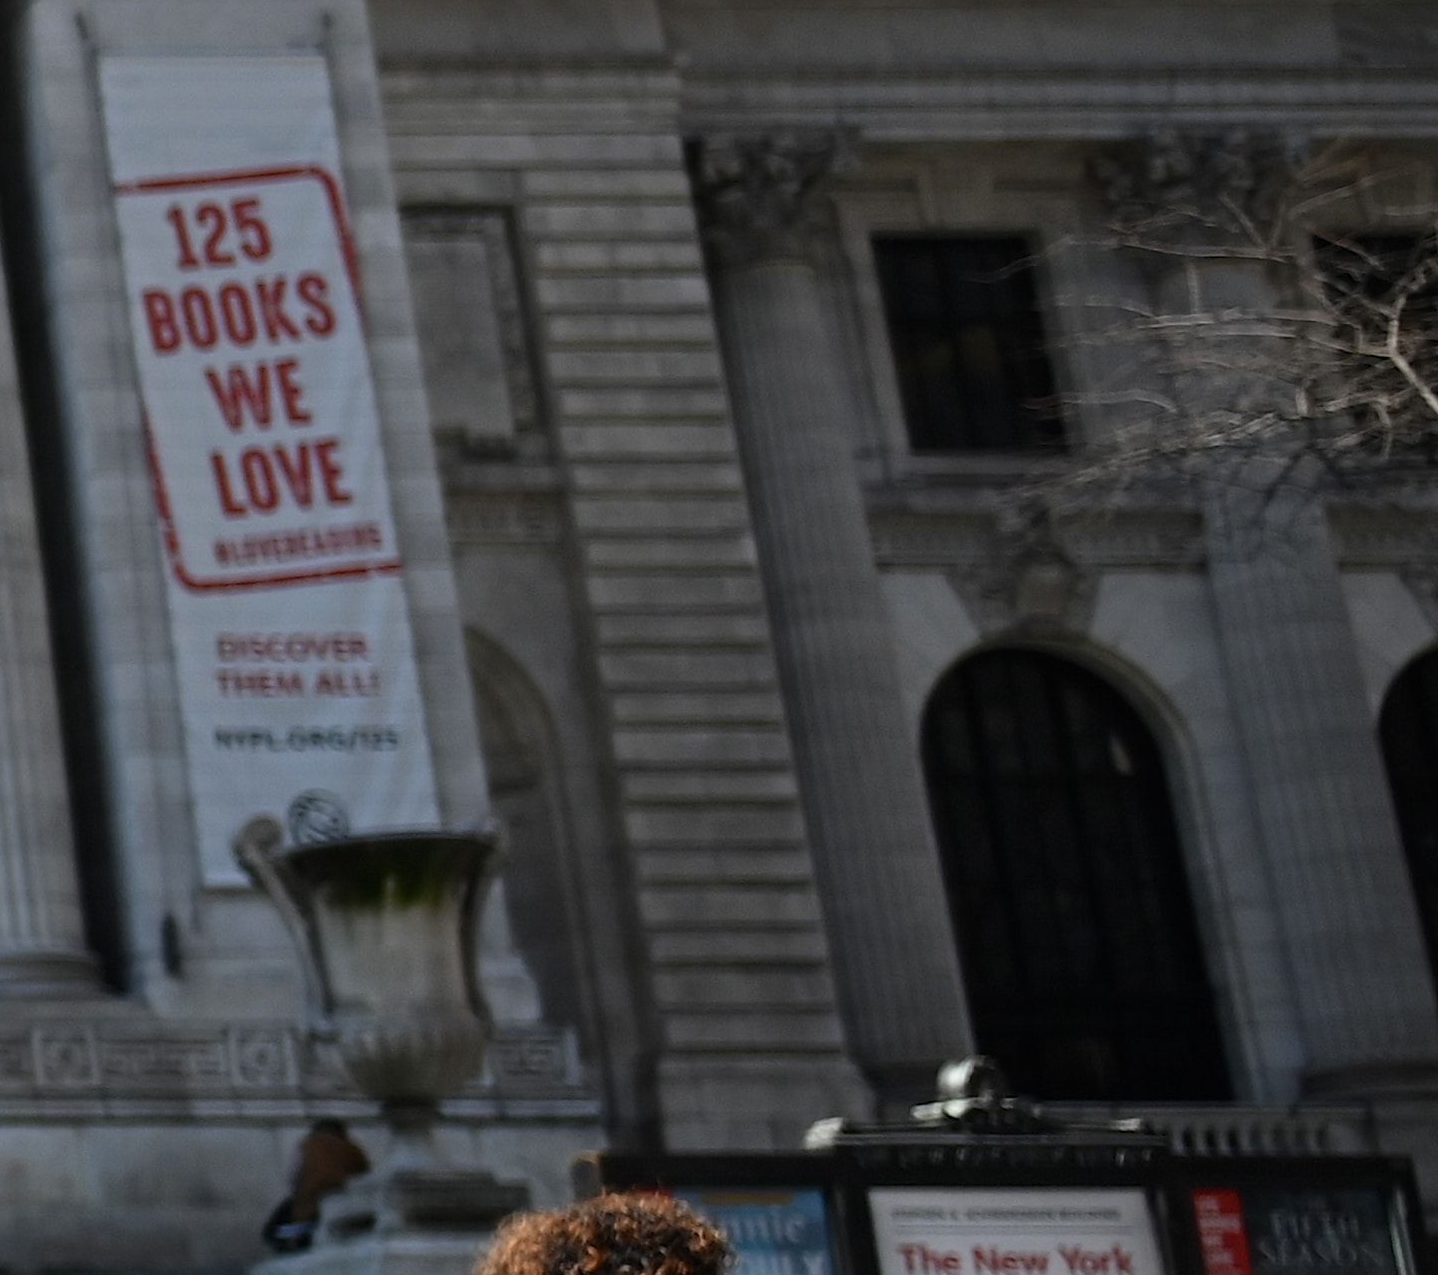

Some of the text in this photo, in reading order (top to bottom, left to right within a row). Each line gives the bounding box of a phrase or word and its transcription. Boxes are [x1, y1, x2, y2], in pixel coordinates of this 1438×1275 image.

[167, 194, 273, 270] 125
[143, 270, 336, 355] BOOKS
[203, 357, 313, 434] WE
[211, 437, 354, 519] LOVE
[214, 667, 304, 698] THEM
[216, 631, 370, 662] DISCOVER
[898, 1243, 961, 1275] The
[971, 1243, 1050, 1275] New
